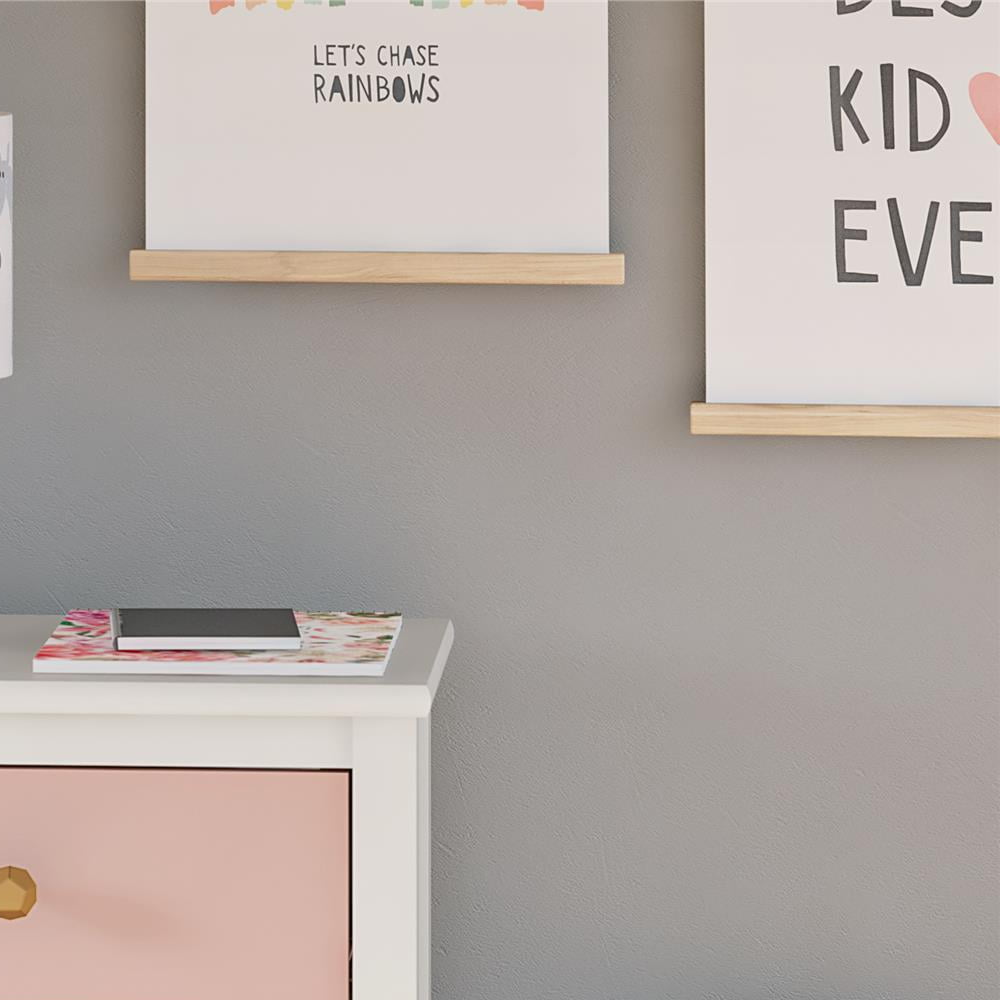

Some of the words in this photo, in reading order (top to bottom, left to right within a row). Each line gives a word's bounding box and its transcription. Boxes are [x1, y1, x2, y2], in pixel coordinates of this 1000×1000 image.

[313, 43, 366, 67] LET'S
[377, 44, 439, 66] CHASE
[313, 72, 440, 104] RAINBOWS
[829, 62, 951, 151] KID
[834, 197, 994, 286] EVE
